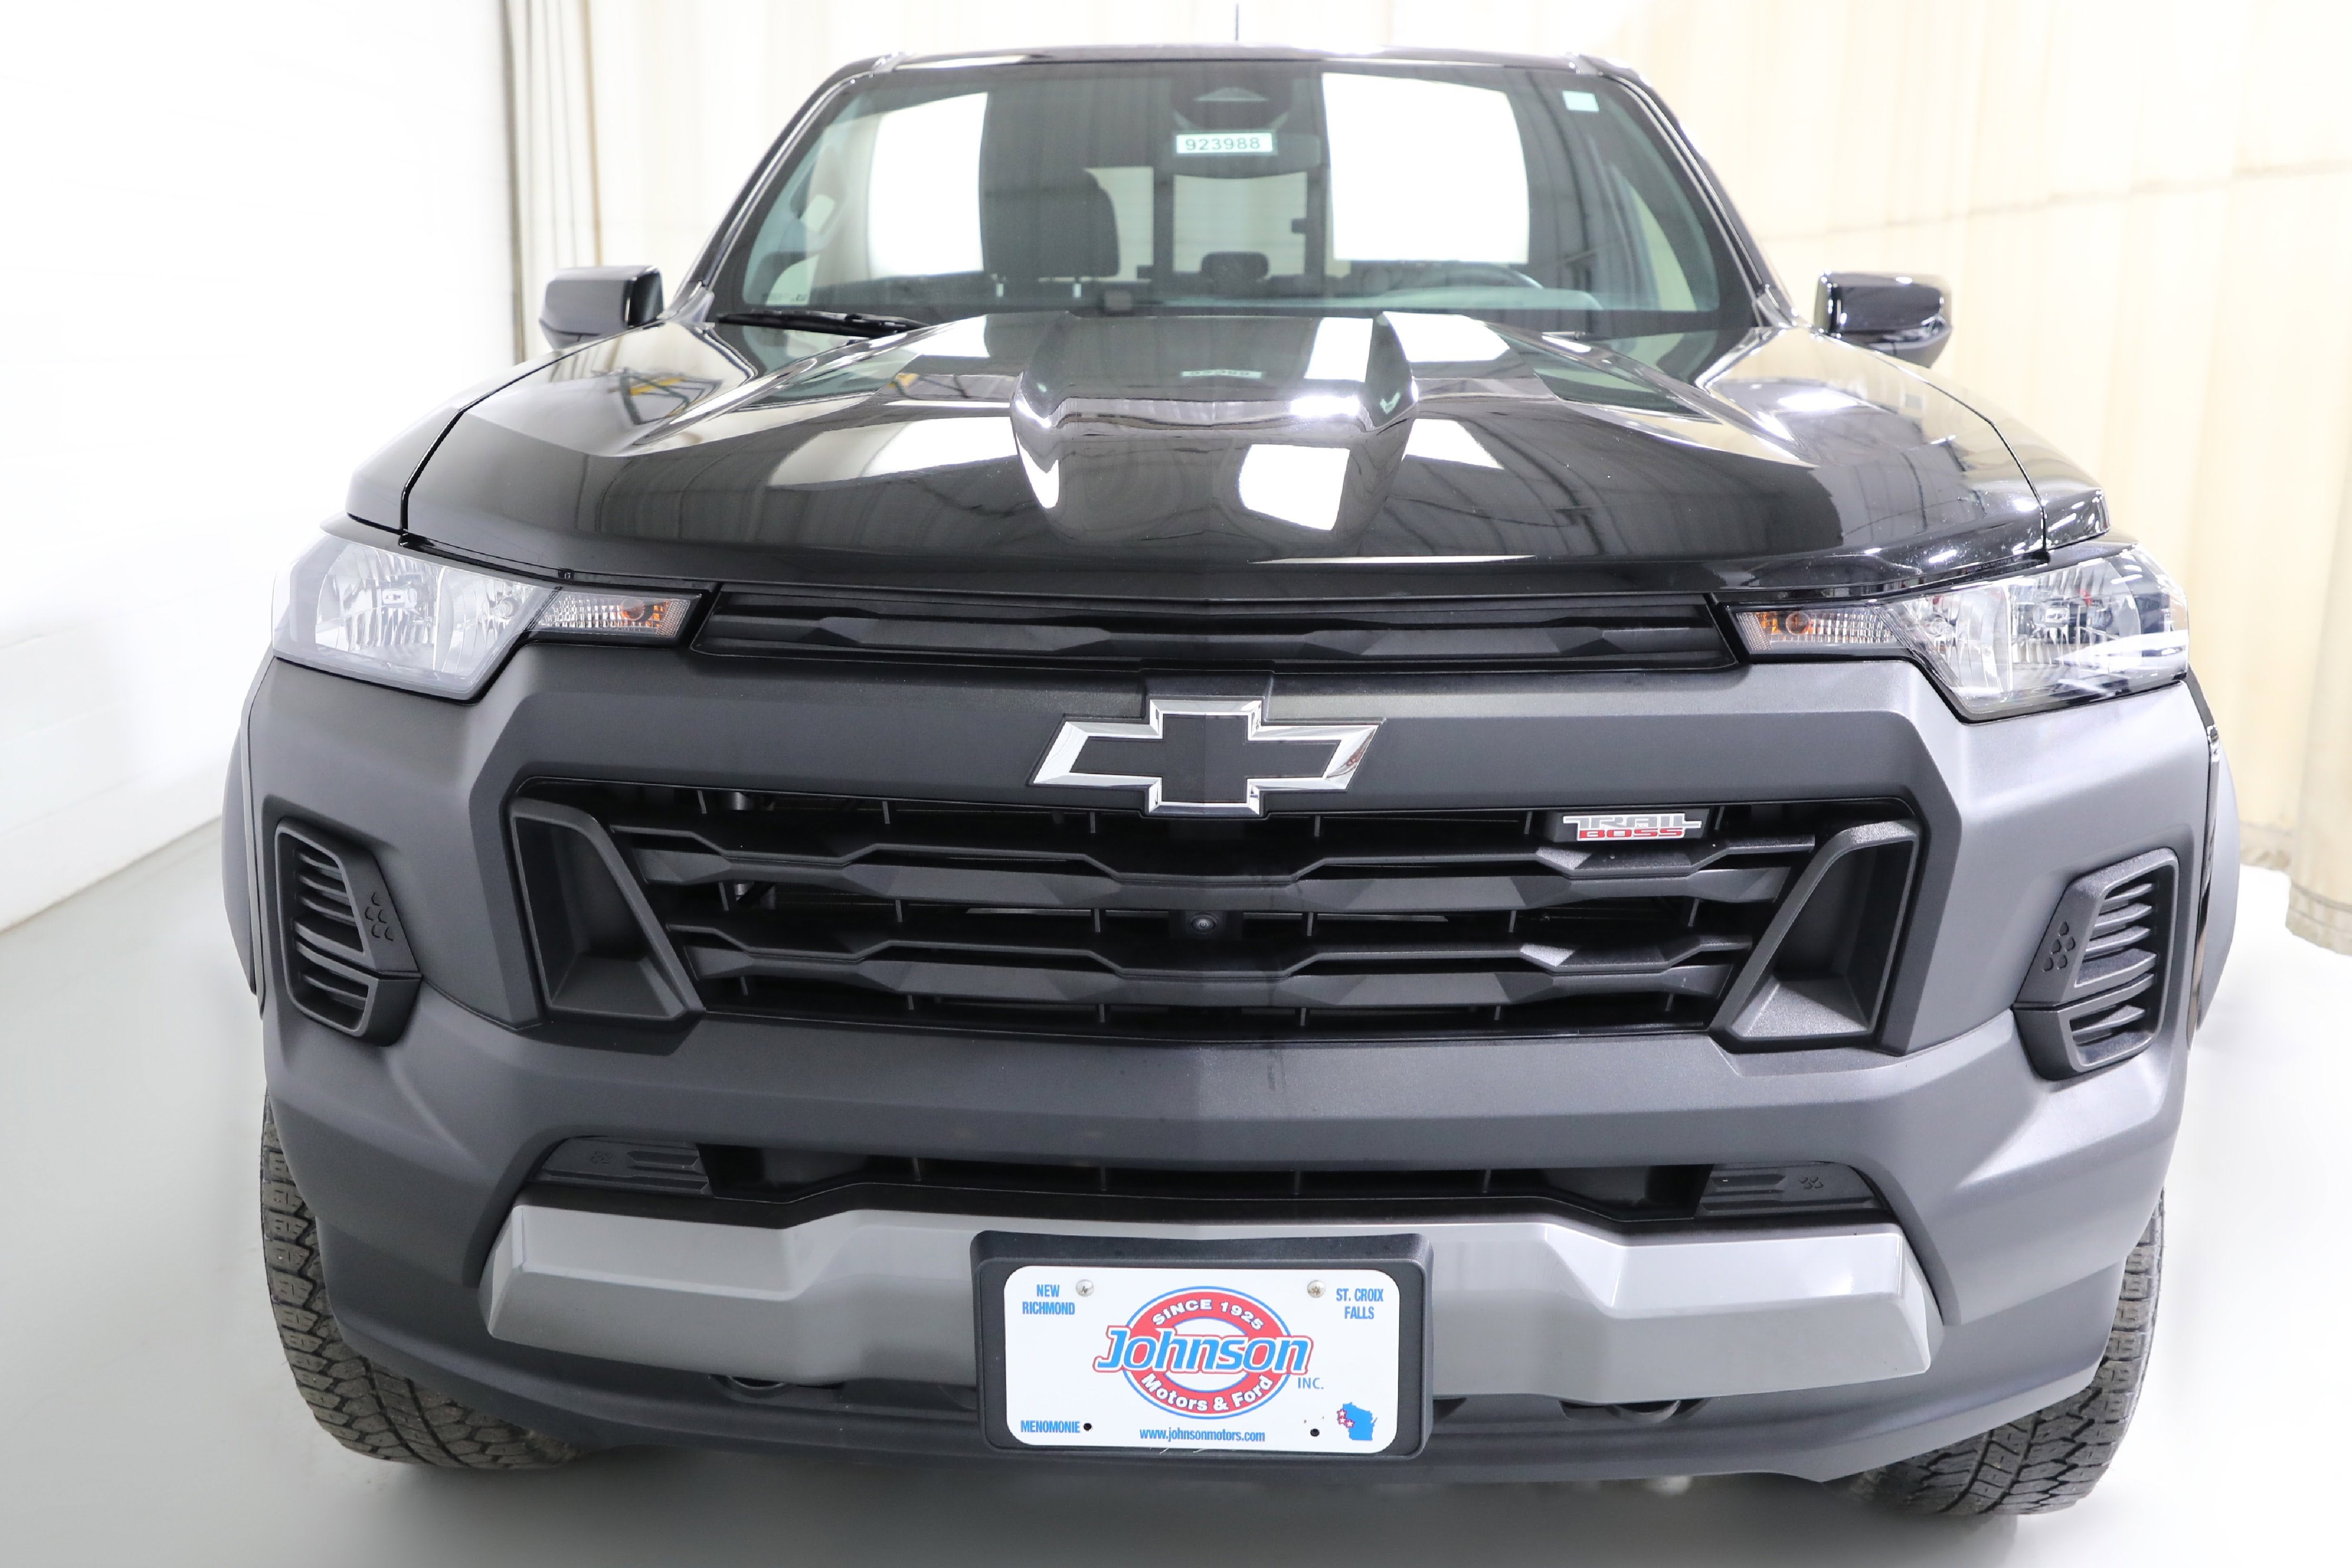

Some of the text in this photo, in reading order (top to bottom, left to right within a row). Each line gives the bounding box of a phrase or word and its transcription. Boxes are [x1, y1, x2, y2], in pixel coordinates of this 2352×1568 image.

[1185, 137, 1260, 151] 923988
[1563, 814, 1702, 829] TRAIL
[1579, 828, 1683, 839] BOSS
[1036, 1284, 1060, 1298] NEW
[1336, 1288, 1384, 1302] ST. CROIX
[1022, 1301, 1075, 1315] RICHMOND
[1152, 1298, 1265, 1330] SINCE 1925
[1344, 1306, 1375, 1319] FALLS
[1094, 1326, 1312, 1373] Johnson
[1297, 1377, 1324, 1390] INC.
[1141, 1372, 1274, 1412] Motors & Ford
[1020, 1420, 1081, 1433] MENOMONIE
[1139, 1427, 1266, 1442] www.johnsonmotors.com
